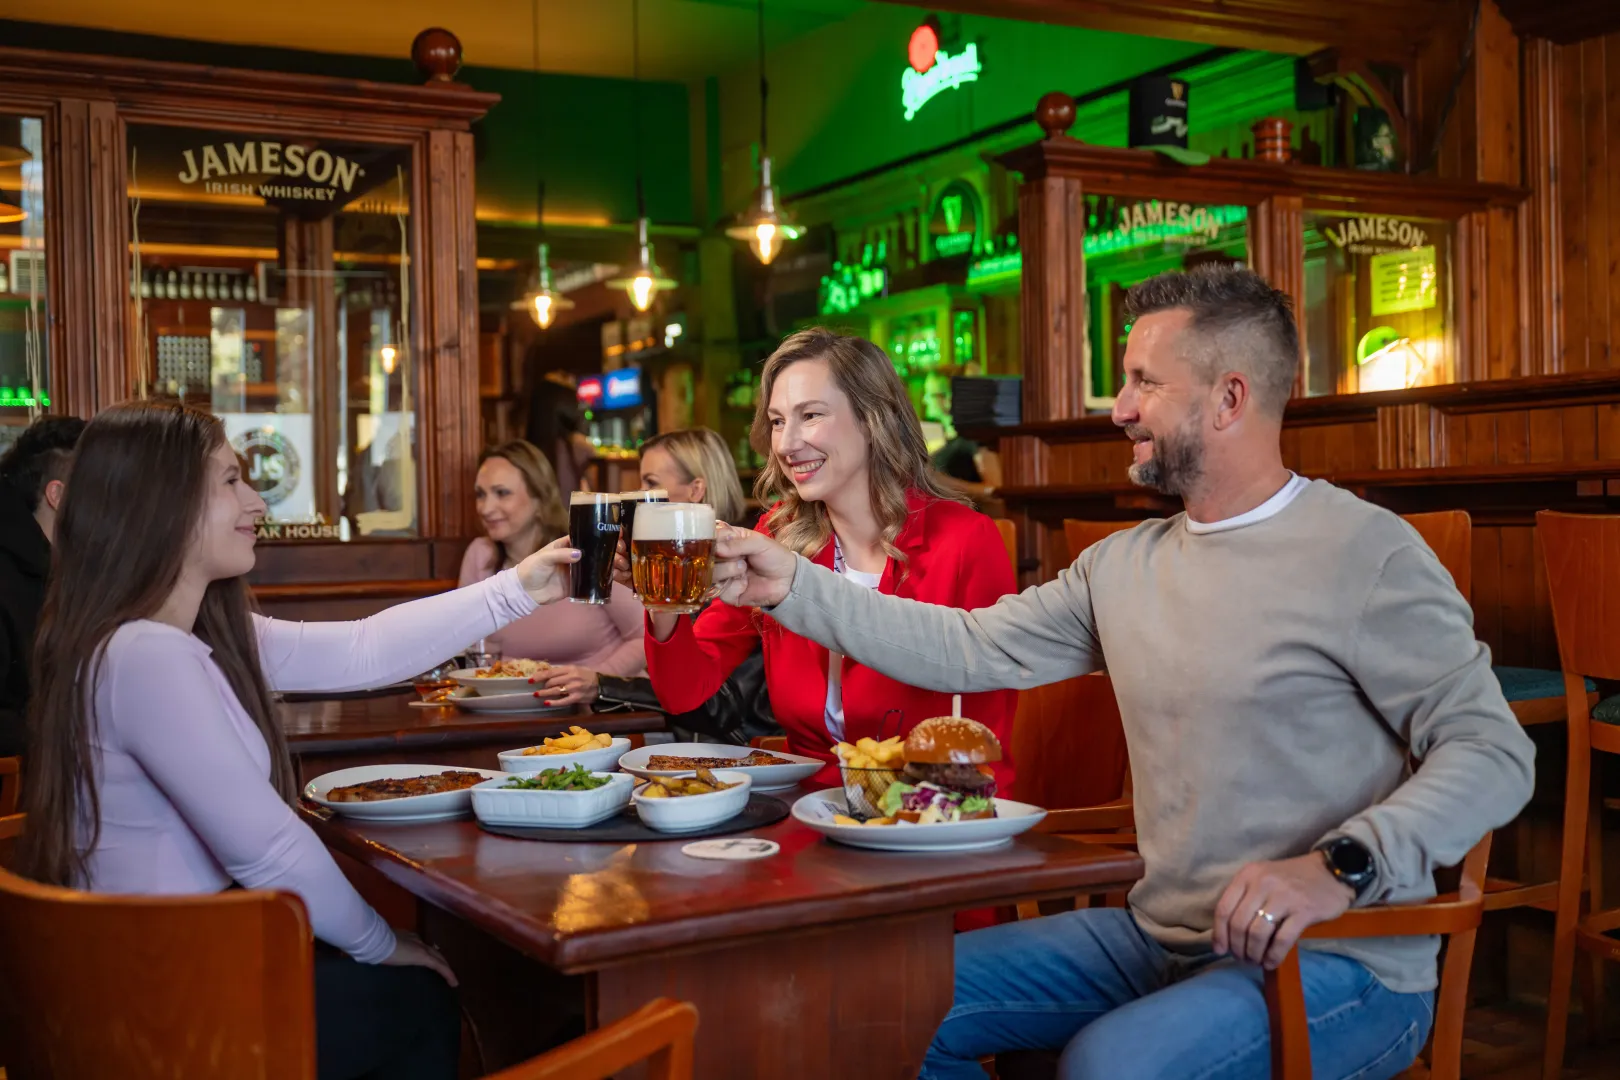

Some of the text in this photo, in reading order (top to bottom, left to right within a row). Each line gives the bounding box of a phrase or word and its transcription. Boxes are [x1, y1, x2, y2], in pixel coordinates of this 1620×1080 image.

[178, 142, 360, 193] JAMESON
[205, 182, 337, 201] IRISH WHISKEY
[1119, 201, 1219, 239] JAMESON
[1338, 217, 1425, 248] JAMESON
[286, 525, 341, 538] HOUSE
